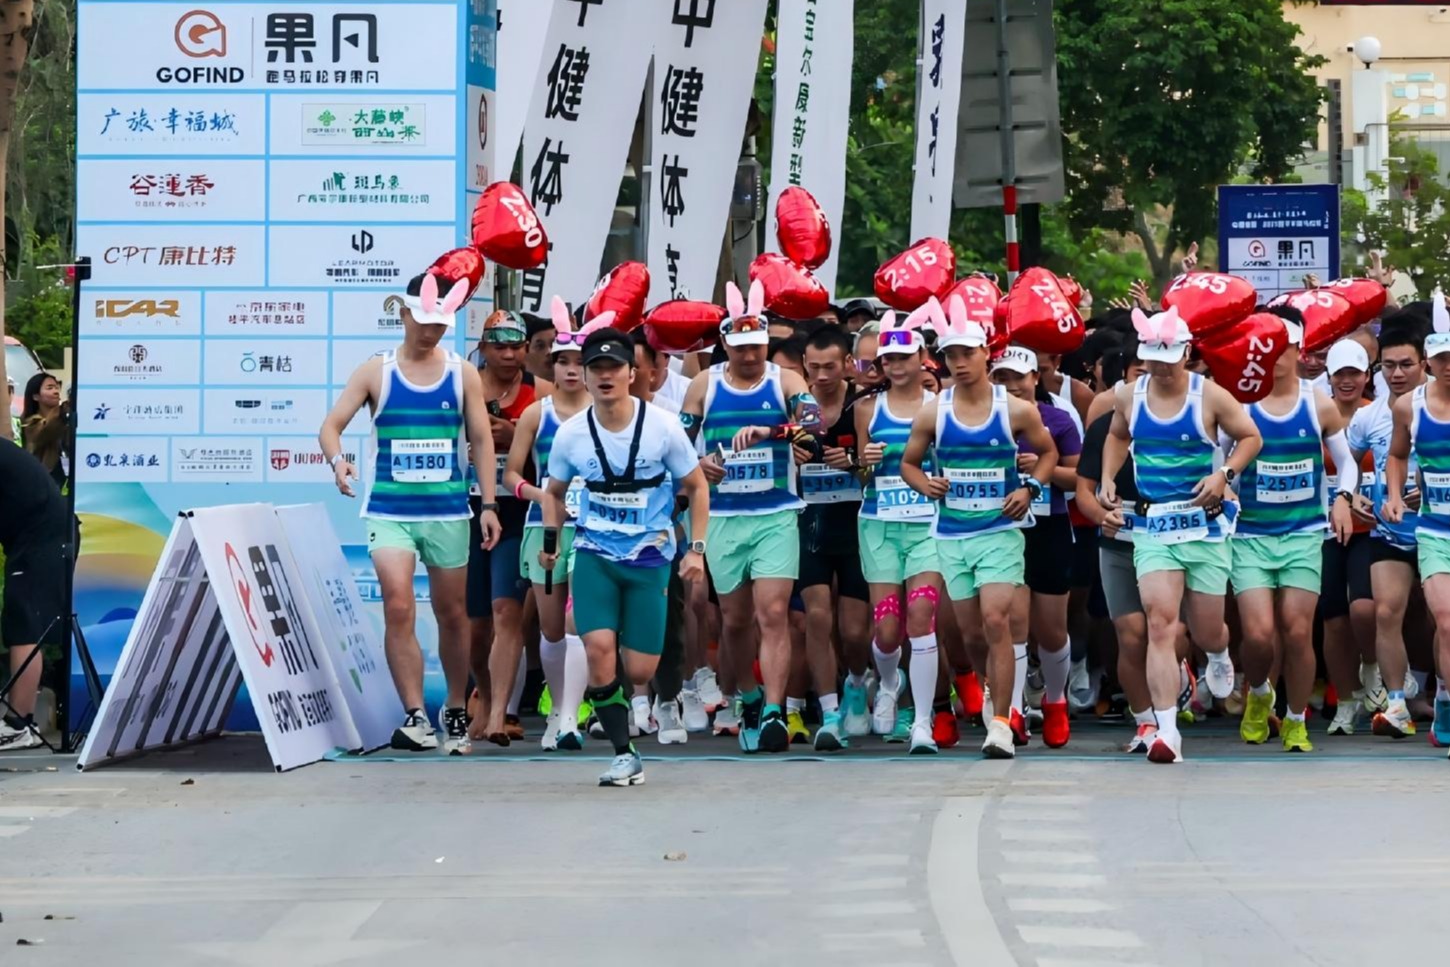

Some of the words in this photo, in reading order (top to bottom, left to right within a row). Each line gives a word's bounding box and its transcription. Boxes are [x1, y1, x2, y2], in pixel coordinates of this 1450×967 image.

[156, 67, 244, 84] GOFIND
[499, 191, 543, 249] 2:30
[103, 246, 156, 266] CPT
[158, 245, 237, 266] 康比特
[883, 245, 938, 294] 2:15
[1169, 272, 1231, 296] 2:45
[1030, 278, 1078, 334] 2:45
[1237, 335, 1274, 394] 2:45
[392, 453, 446, 470] A1580
[723, 464, 768, 481] 0578
[1256, 475, 1309, 491] A2576
[1149, 513, 1201, 531] A2385
